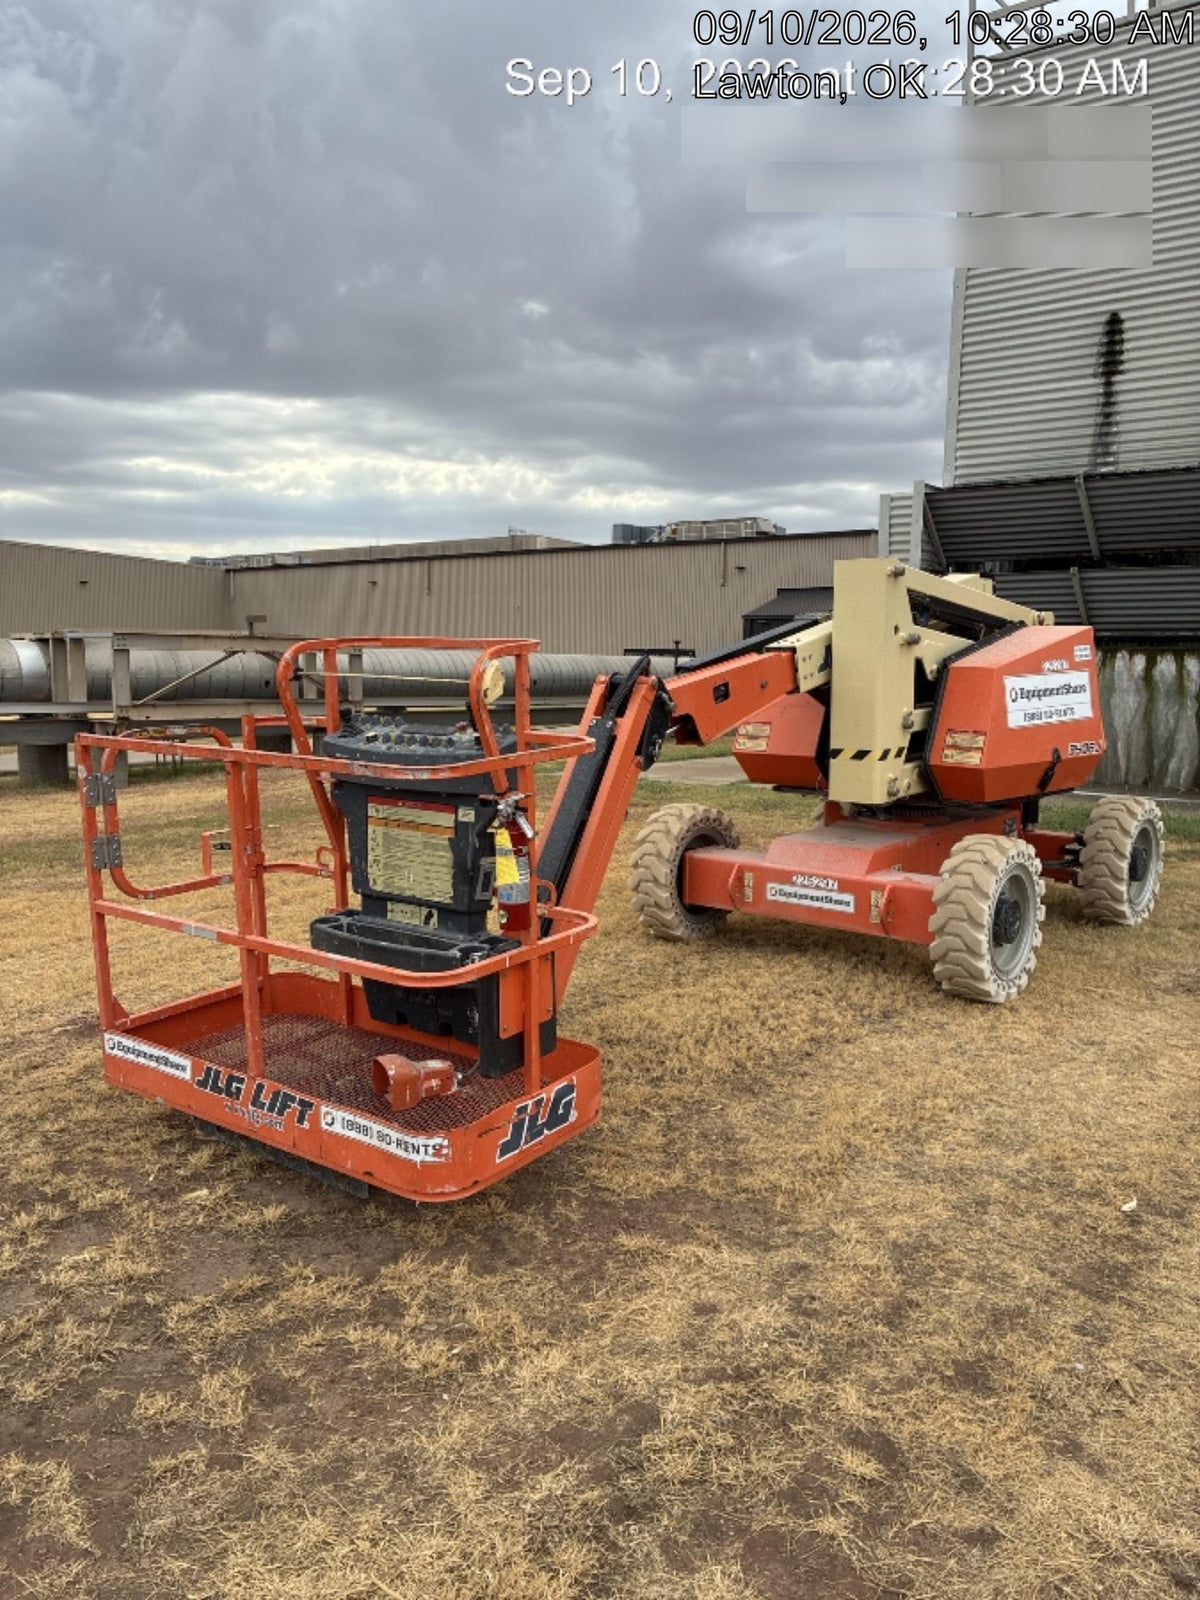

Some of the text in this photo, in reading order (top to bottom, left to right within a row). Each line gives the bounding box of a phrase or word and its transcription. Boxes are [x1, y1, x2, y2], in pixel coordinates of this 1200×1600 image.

[195, 1063, 316, 1129] JLG LIFT
[496, 1080, 577, 1164] JLG
